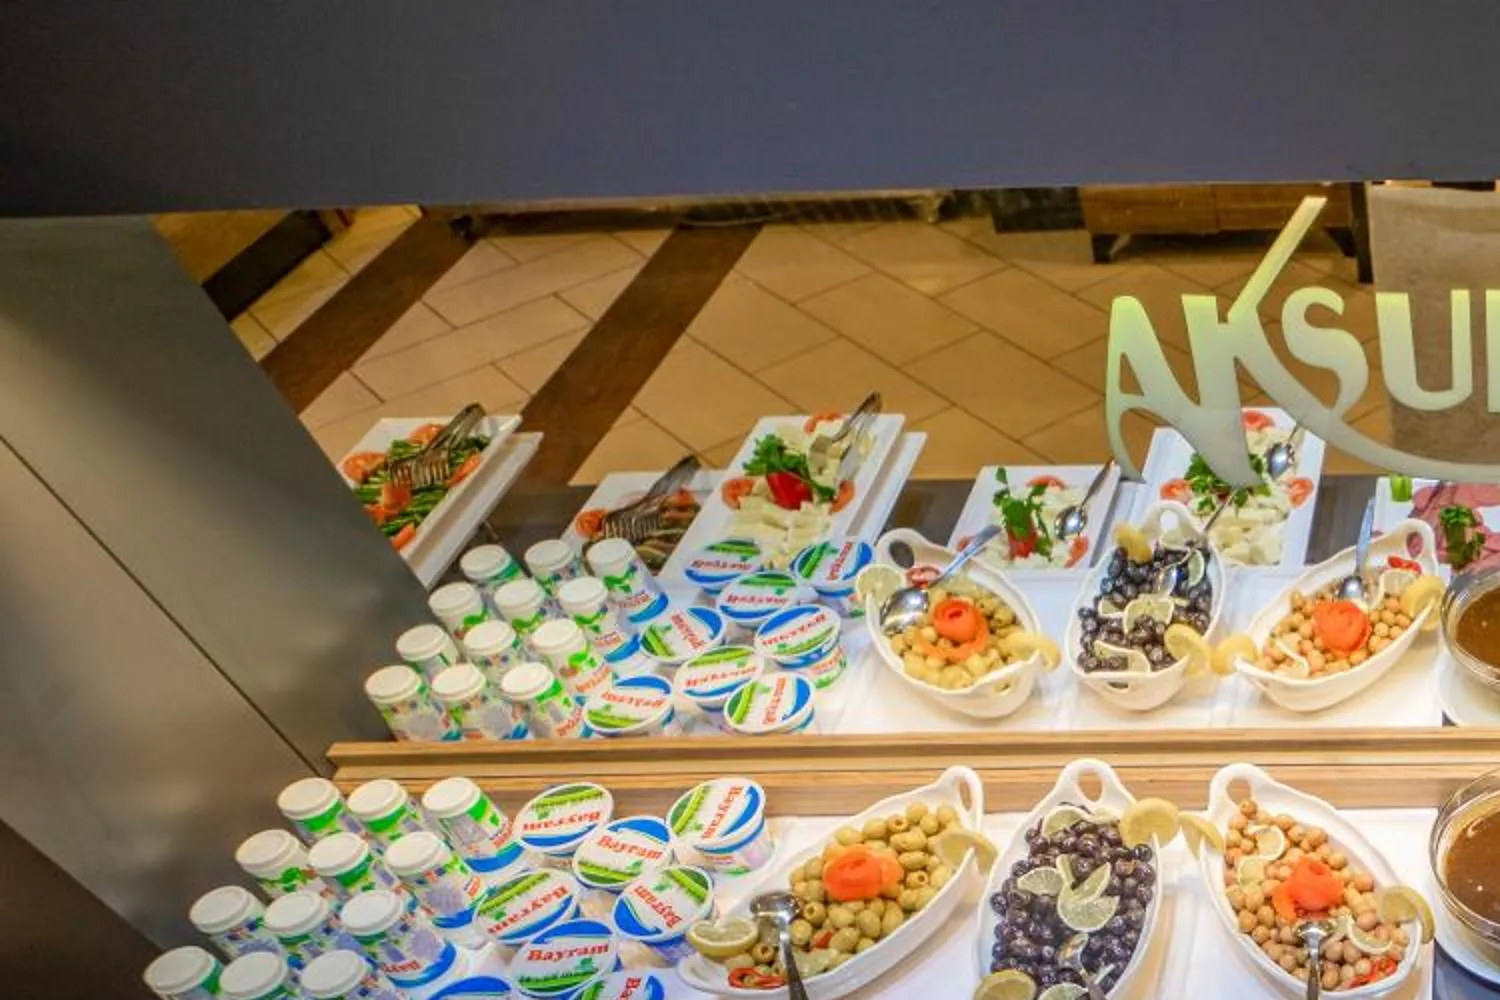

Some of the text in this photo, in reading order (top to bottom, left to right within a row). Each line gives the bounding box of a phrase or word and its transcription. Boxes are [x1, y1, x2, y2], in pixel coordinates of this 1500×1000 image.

[598, 835, 663, 860] Bayram
[488, 886, 568, 934] Bayram
[633, 884, 683, 929] Bayram
[526, 943, 609, 962] Bayram
